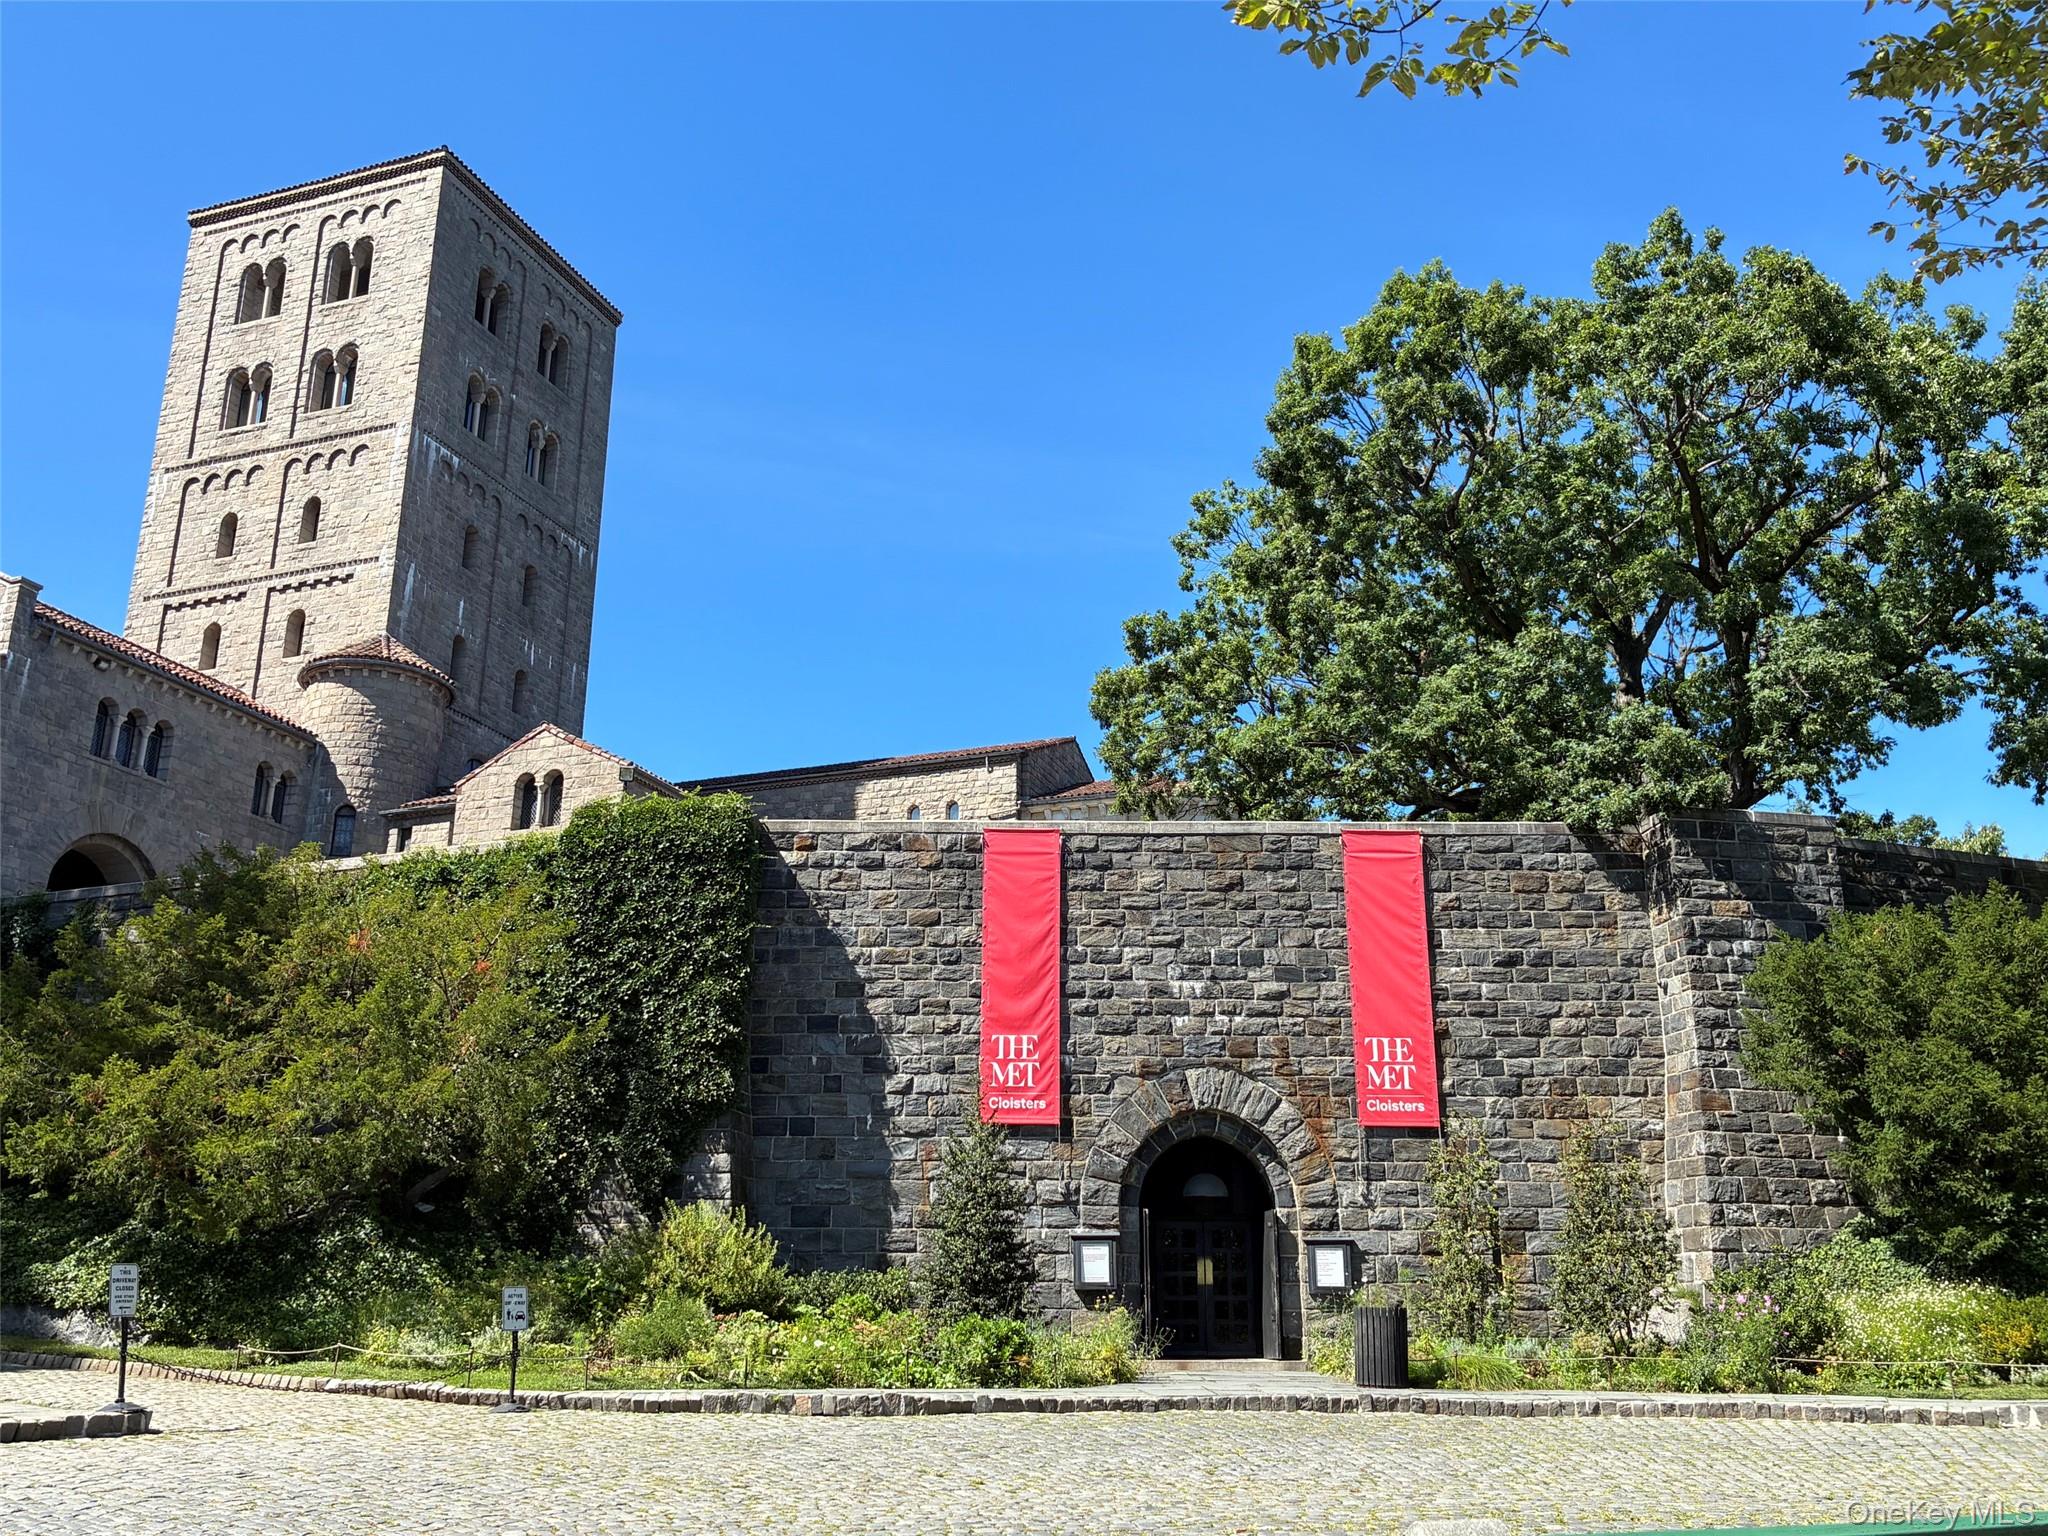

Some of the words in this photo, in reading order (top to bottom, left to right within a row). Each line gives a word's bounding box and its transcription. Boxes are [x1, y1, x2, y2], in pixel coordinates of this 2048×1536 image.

[991, 1034, 1040, 1060] THE
[1364, 1037, 1414, 1062] THE
[989, 1061, 1041, 1088] MET
[1365, 1064, 1417, 1090] MET
[988, 1096, 1047, 1109] Cloisters
[1366, 1099, 1425, 1112] Cloisters
